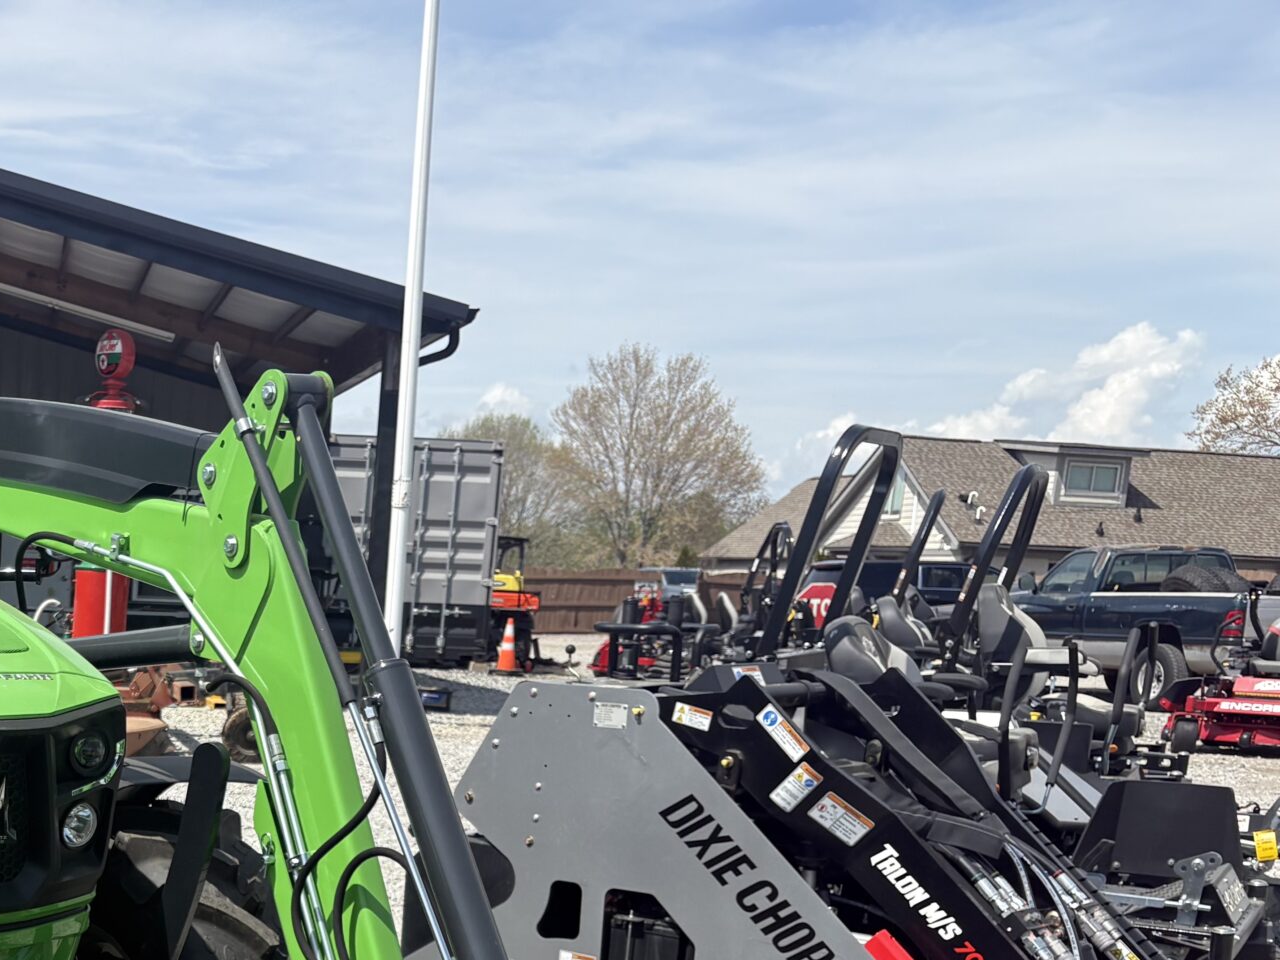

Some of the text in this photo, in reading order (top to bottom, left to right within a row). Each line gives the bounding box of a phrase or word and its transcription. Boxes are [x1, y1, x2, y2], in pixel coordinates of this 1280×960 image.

[658, 793, 758, 887] DIXIE
[869, 843, 931, 908] TALON
[918, 902, 963, 941] M/S
